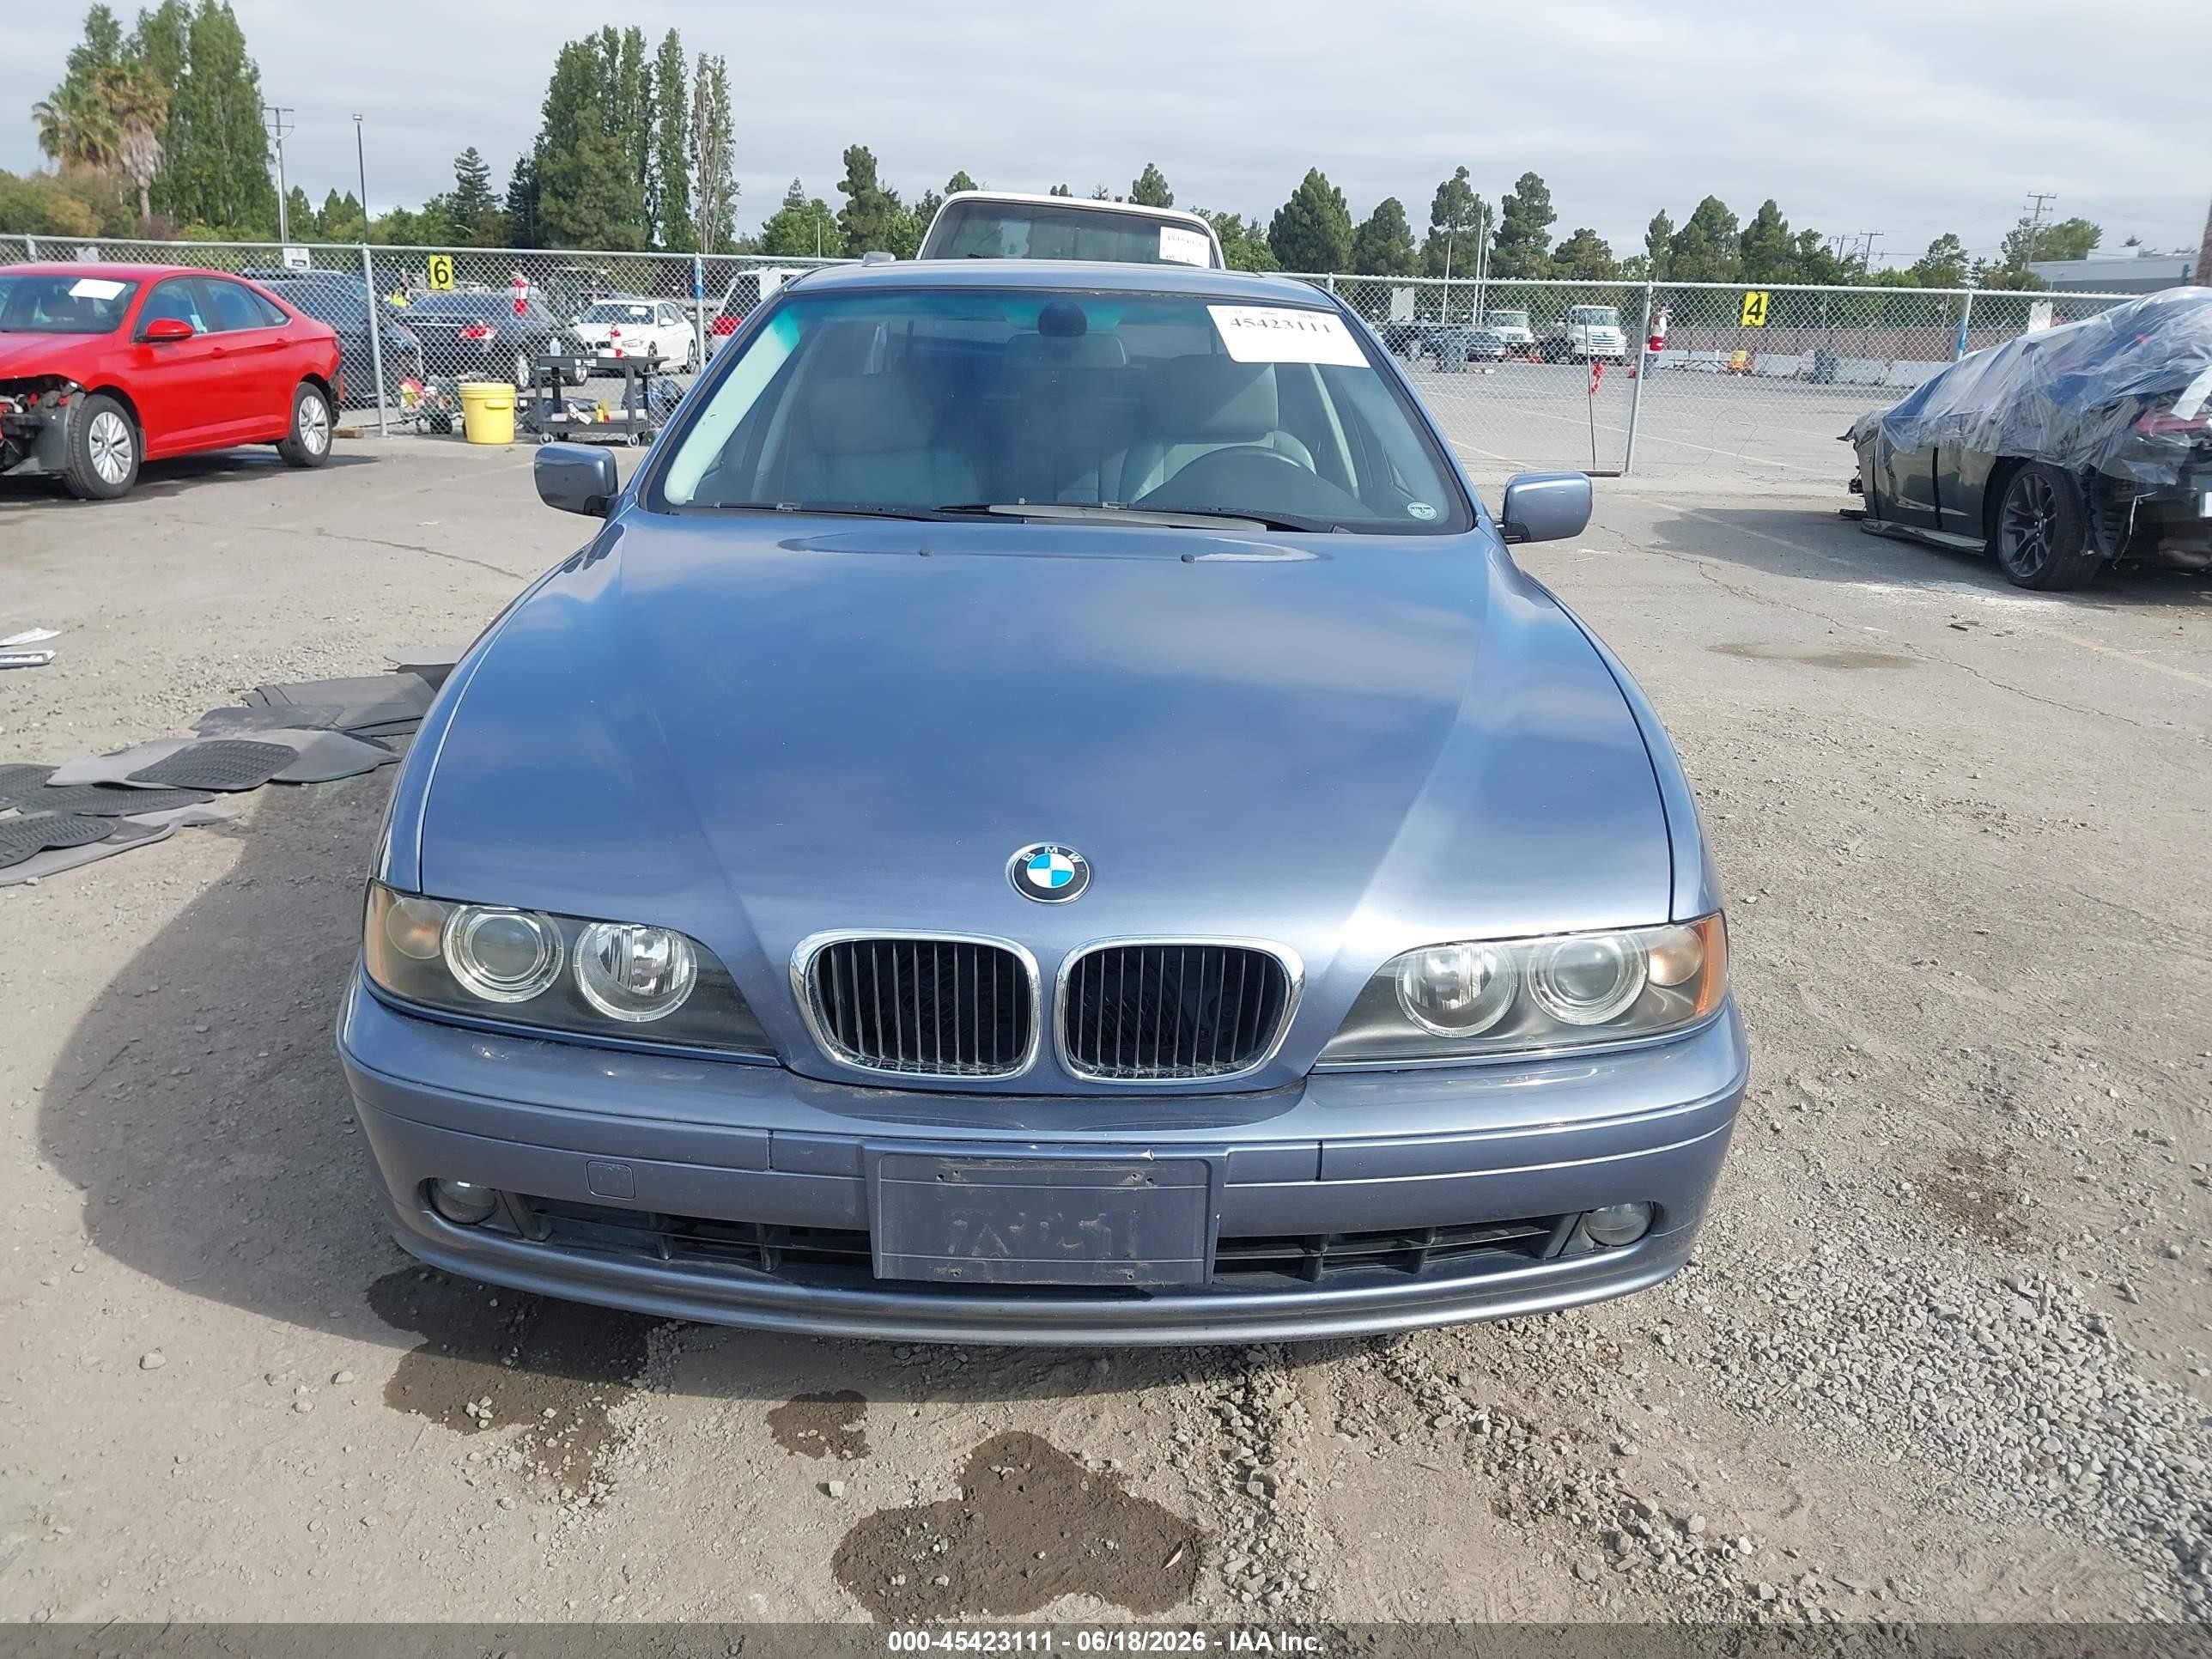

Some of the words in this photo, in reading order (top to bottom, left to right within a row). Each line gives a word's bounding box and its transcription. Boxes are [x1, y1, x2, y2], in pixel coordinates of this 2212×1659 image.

[434, 260, 449, 284] 6
[1747, 296, 1763, 320] 4
[1230, 317, 1332, 334] 45423111
[1021, 846, 1083, 863] BMW
